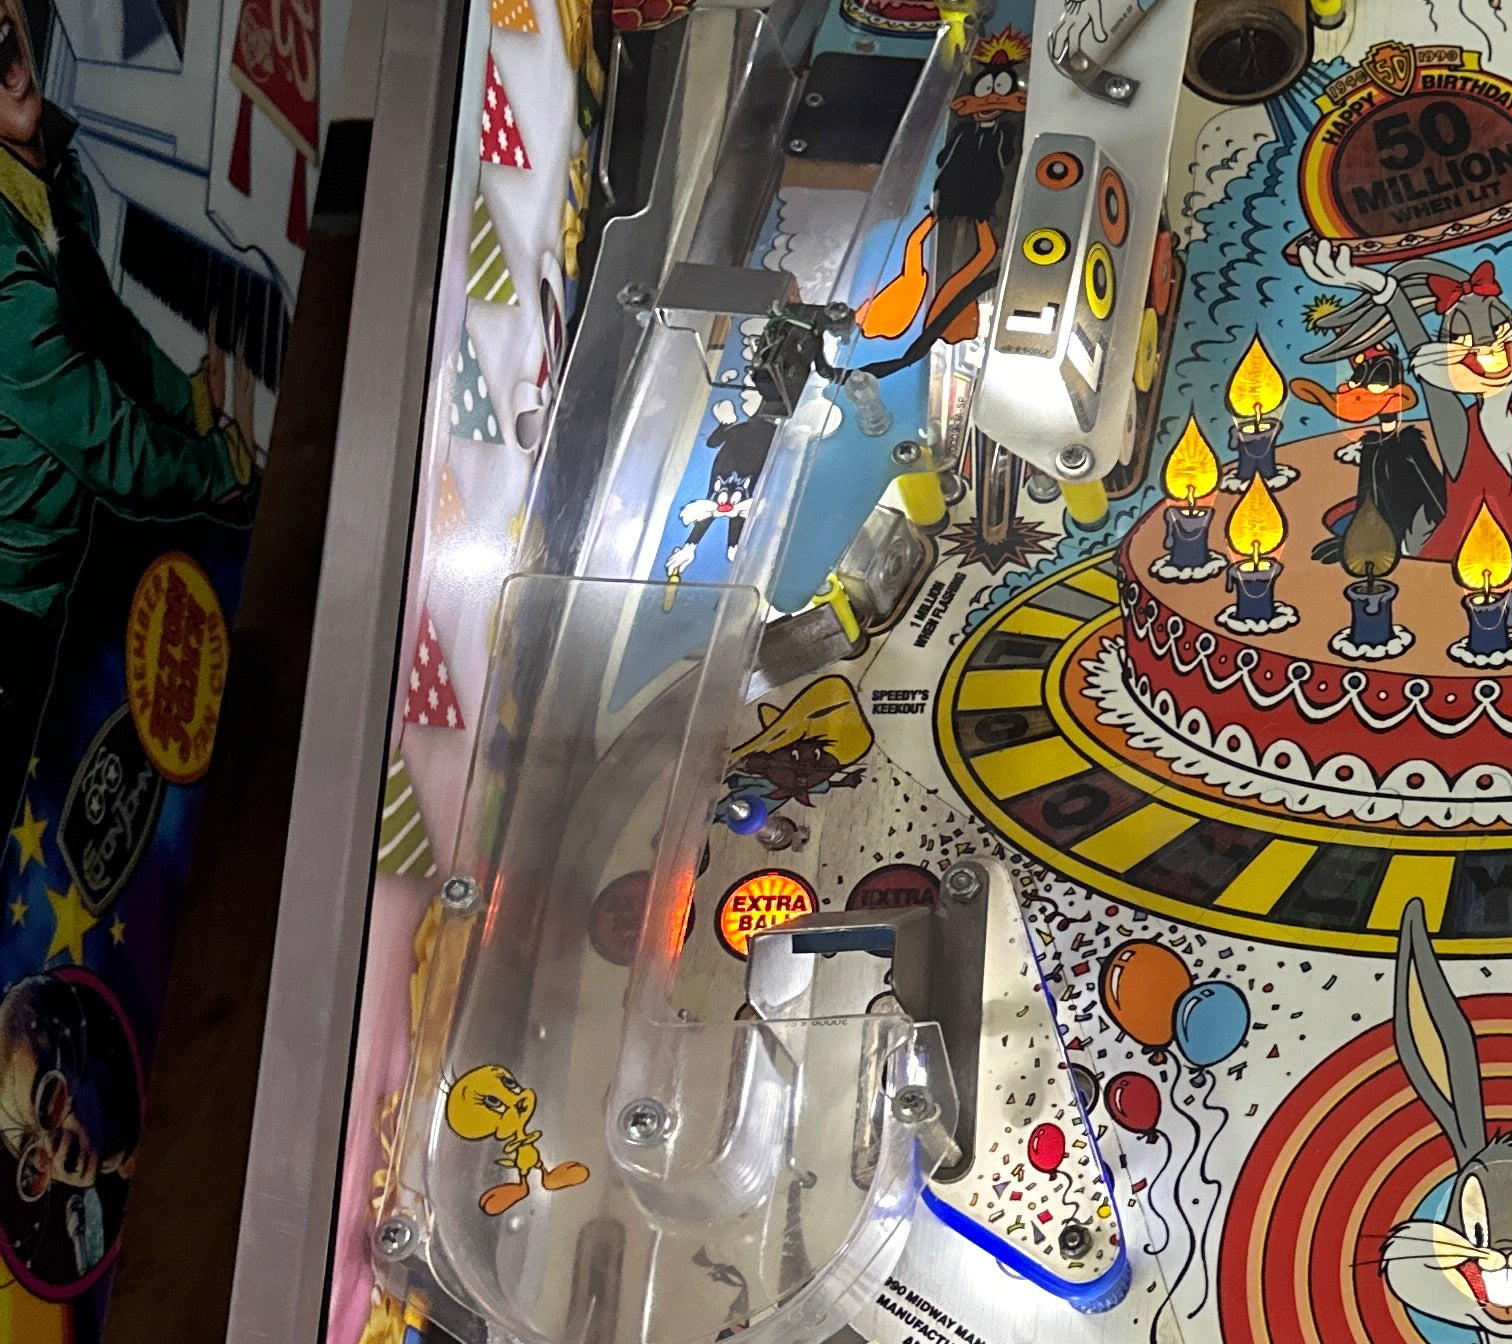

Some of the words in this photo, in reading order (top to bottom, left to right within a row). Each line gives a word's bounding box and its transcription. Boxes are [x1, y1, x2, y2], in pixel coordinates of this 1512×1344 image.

[1322, 92, 1374, 147] HAPPY
[1372, 101, 1471, 171] 50
[872, 690, 929, 701] SPEEDY'S
[872, 703, 926, 714] KEEKOUT
[733, 895, 807, 912] EXTRA
[905, 1291, 957, 1329] MIDWAY
